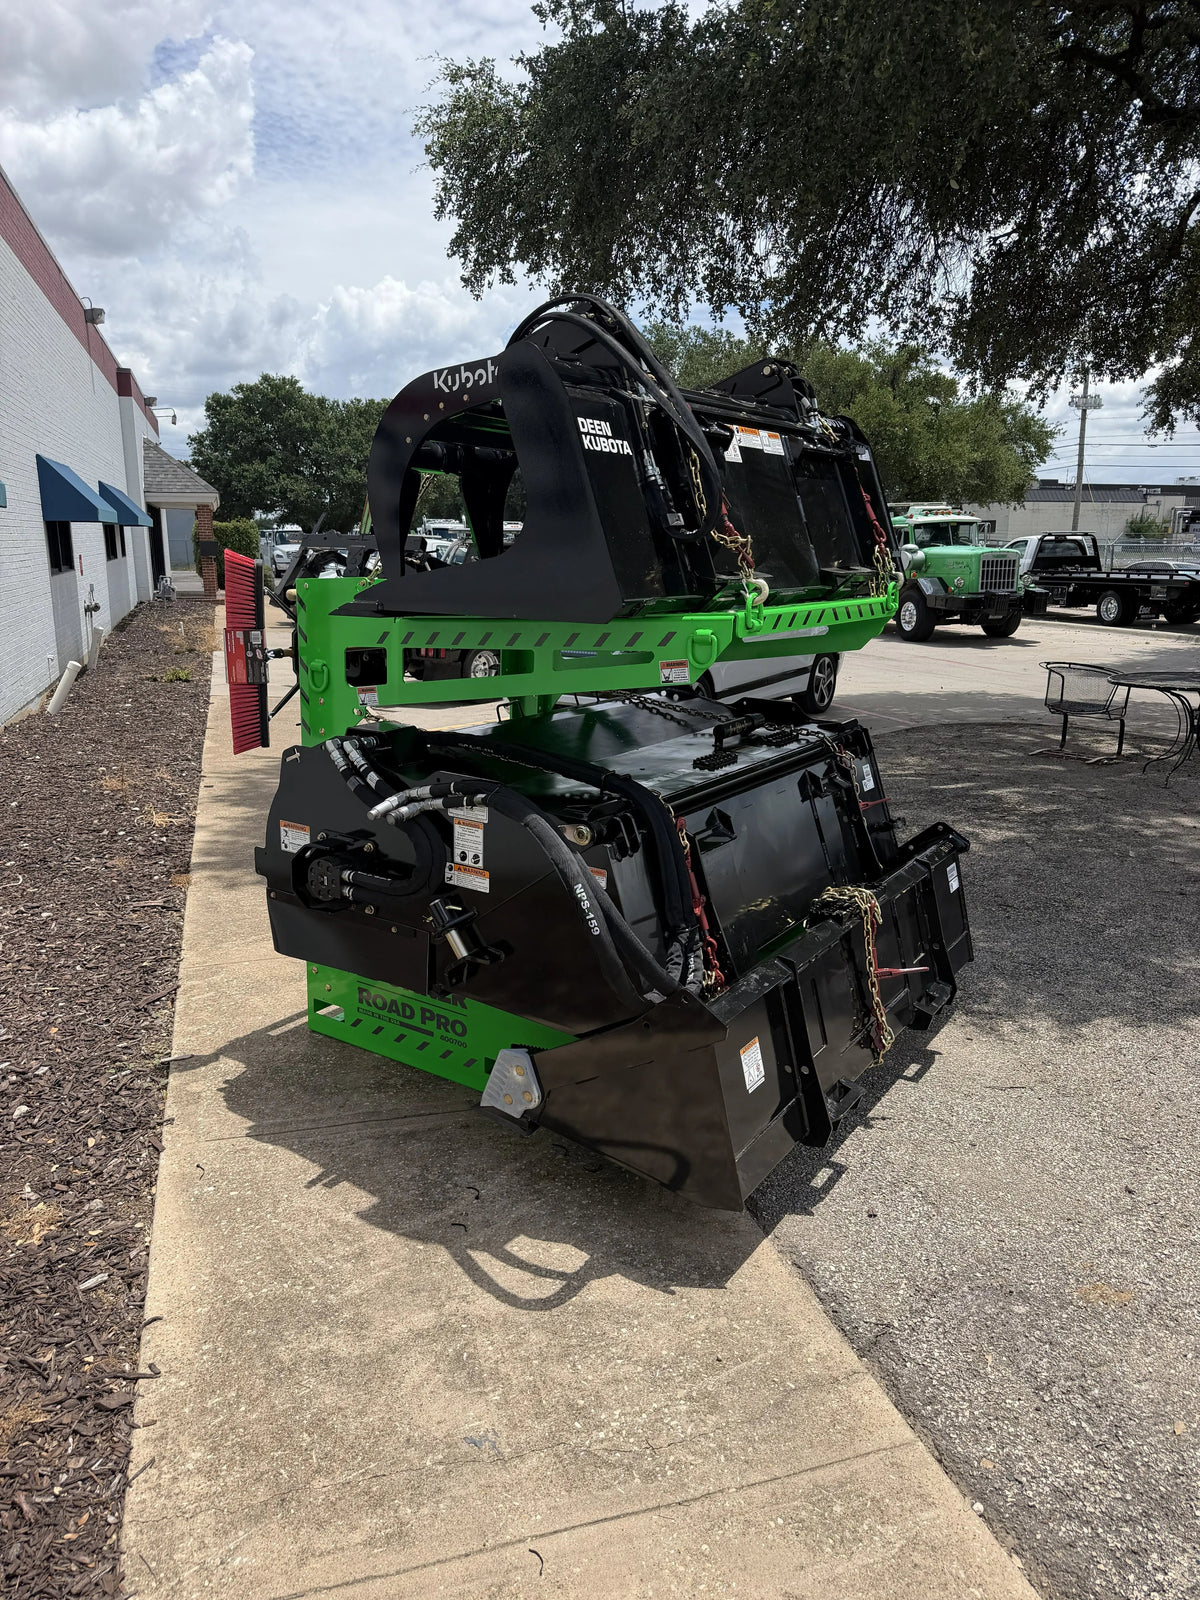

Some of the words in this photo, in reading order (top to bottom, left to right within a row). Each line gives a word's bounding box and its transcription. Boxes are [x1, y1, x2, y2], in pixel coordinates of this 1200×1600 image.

[433, 360, 499, 393] Kubot
[577, 416, 612, 436] DEEN
[581, 434, 632, 456] KUBOTA
[463, 866, 486, 877] WARNING
[574, 883, 600, 936] NPS-159
[357, 986, 415, 1020] ROAD
[420, 1006, 468, 1037] PRO
